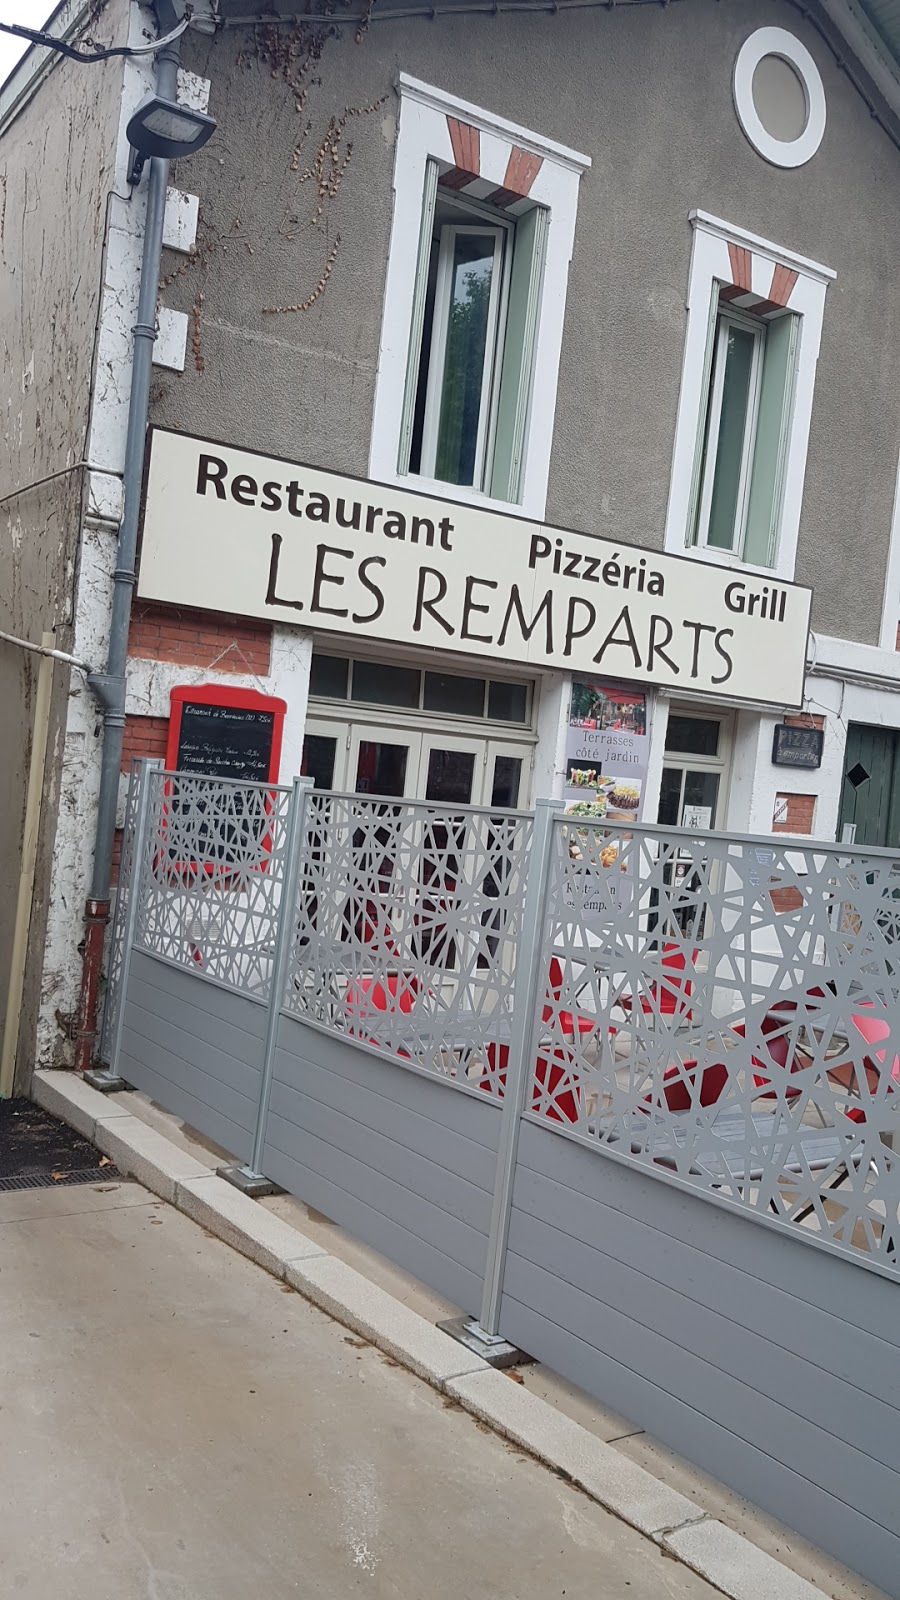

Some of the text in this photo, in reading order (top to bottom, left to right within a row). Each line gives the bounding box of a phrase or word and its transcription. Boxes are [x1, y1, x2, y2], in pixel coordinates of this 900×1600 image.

[196, 453, 455, 551] Restaurant
[528, 534, 665, 597] Pizzéria
[265, 533, 734, 684] LES REMPARTS
[724, 582, 787, 622] Grill
[576, 747, 639, 763] côté jardin
[583, 730, 634, 747] Terrasses
[778, 730, 819, 749] PIZZA
